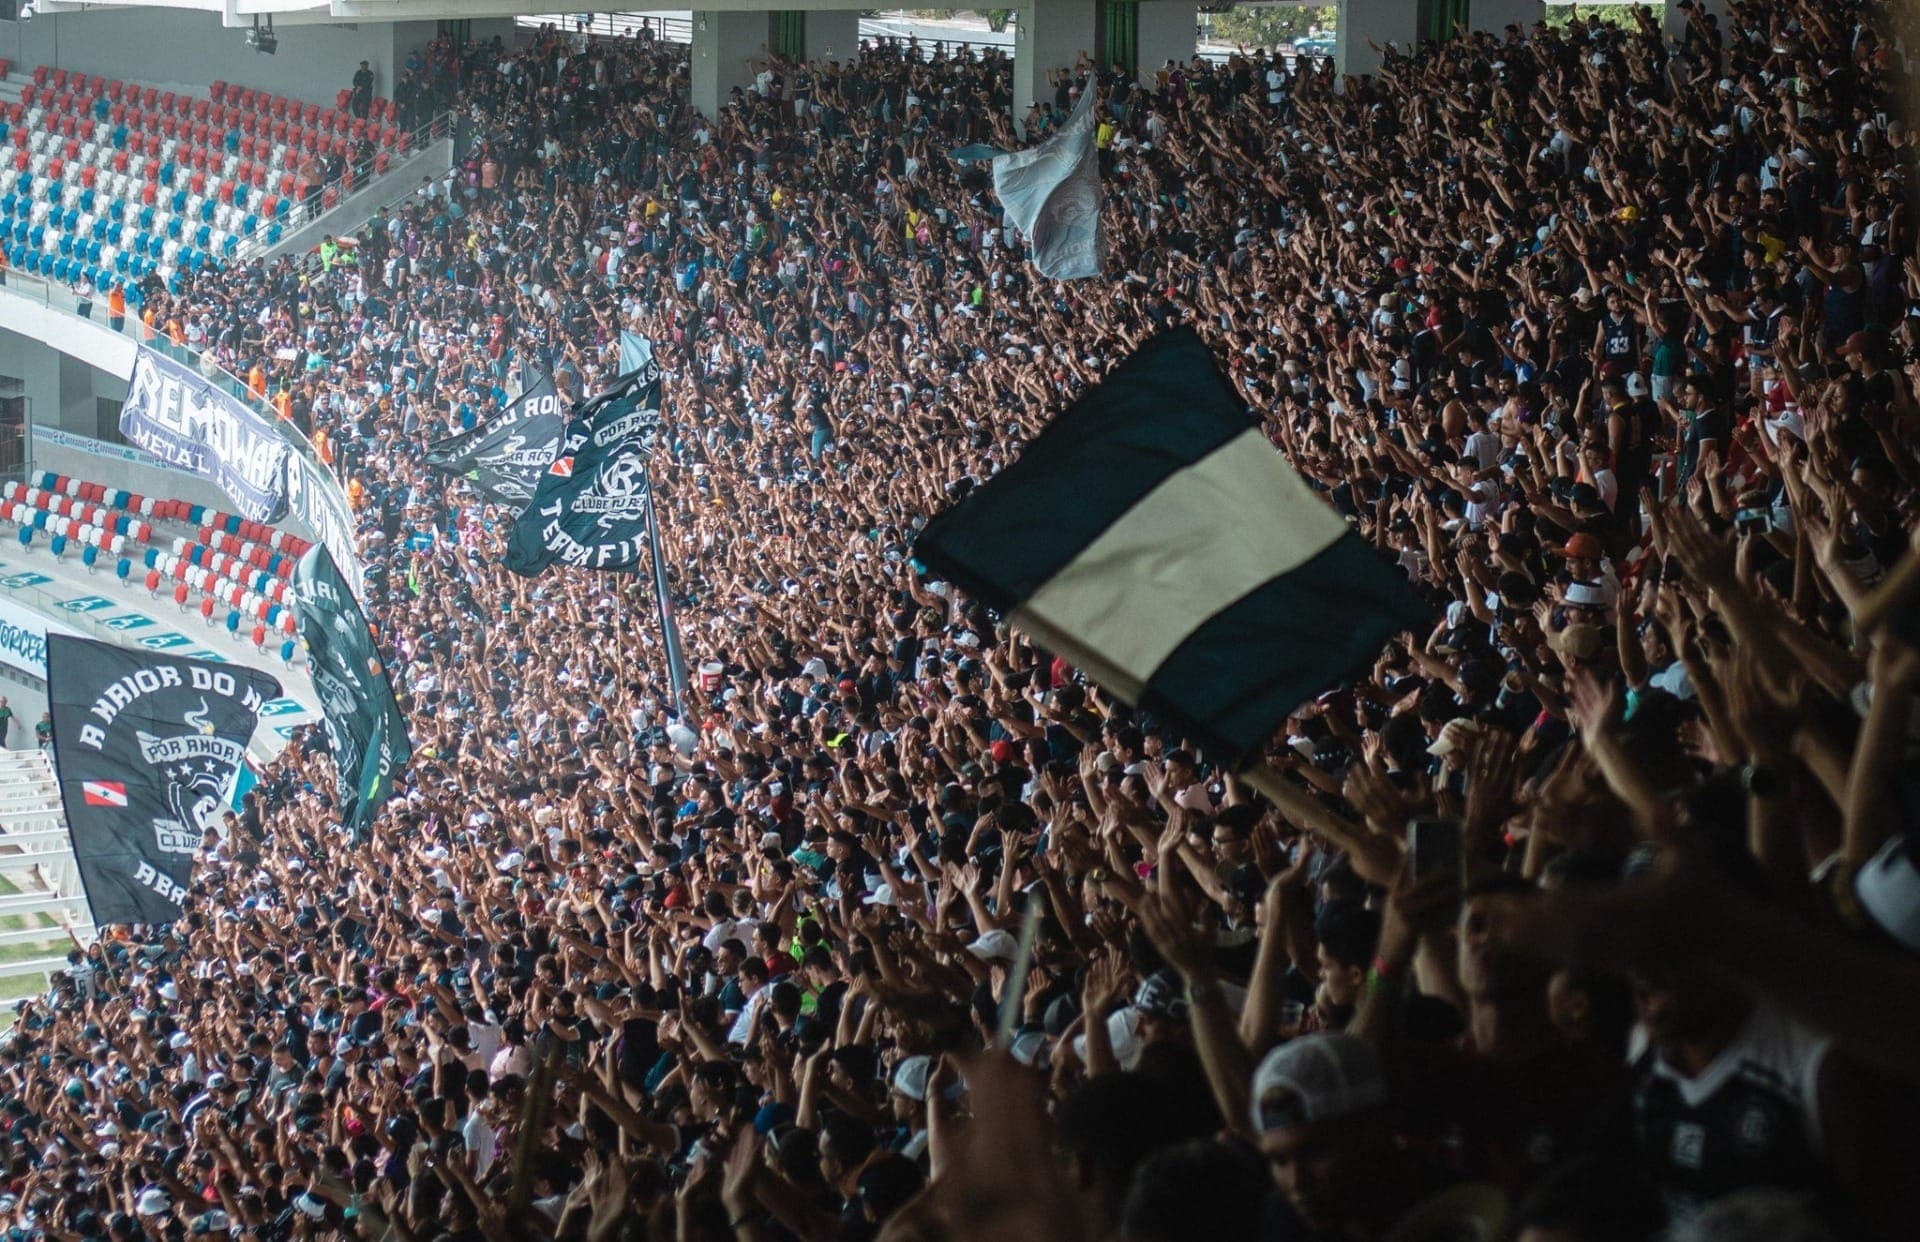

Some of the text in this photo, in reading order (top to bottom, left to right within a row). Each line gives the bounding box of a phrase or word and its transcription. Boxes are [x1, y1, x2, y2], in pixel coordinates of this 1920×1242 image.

[1610, 336, 1629, 354] 33
[133, 422, 210, 474] METAL
[216, 467, 271, 522] AZULINO
[0, 619, 46, 664] ORCER
[90, 665, 183, 726] MAIOR
[190, 666, 235, 697] DO
[241, 685, 262, 713] N
[148, 740, 182, 762] POR
[187, 738, 235, 760] AMOR
